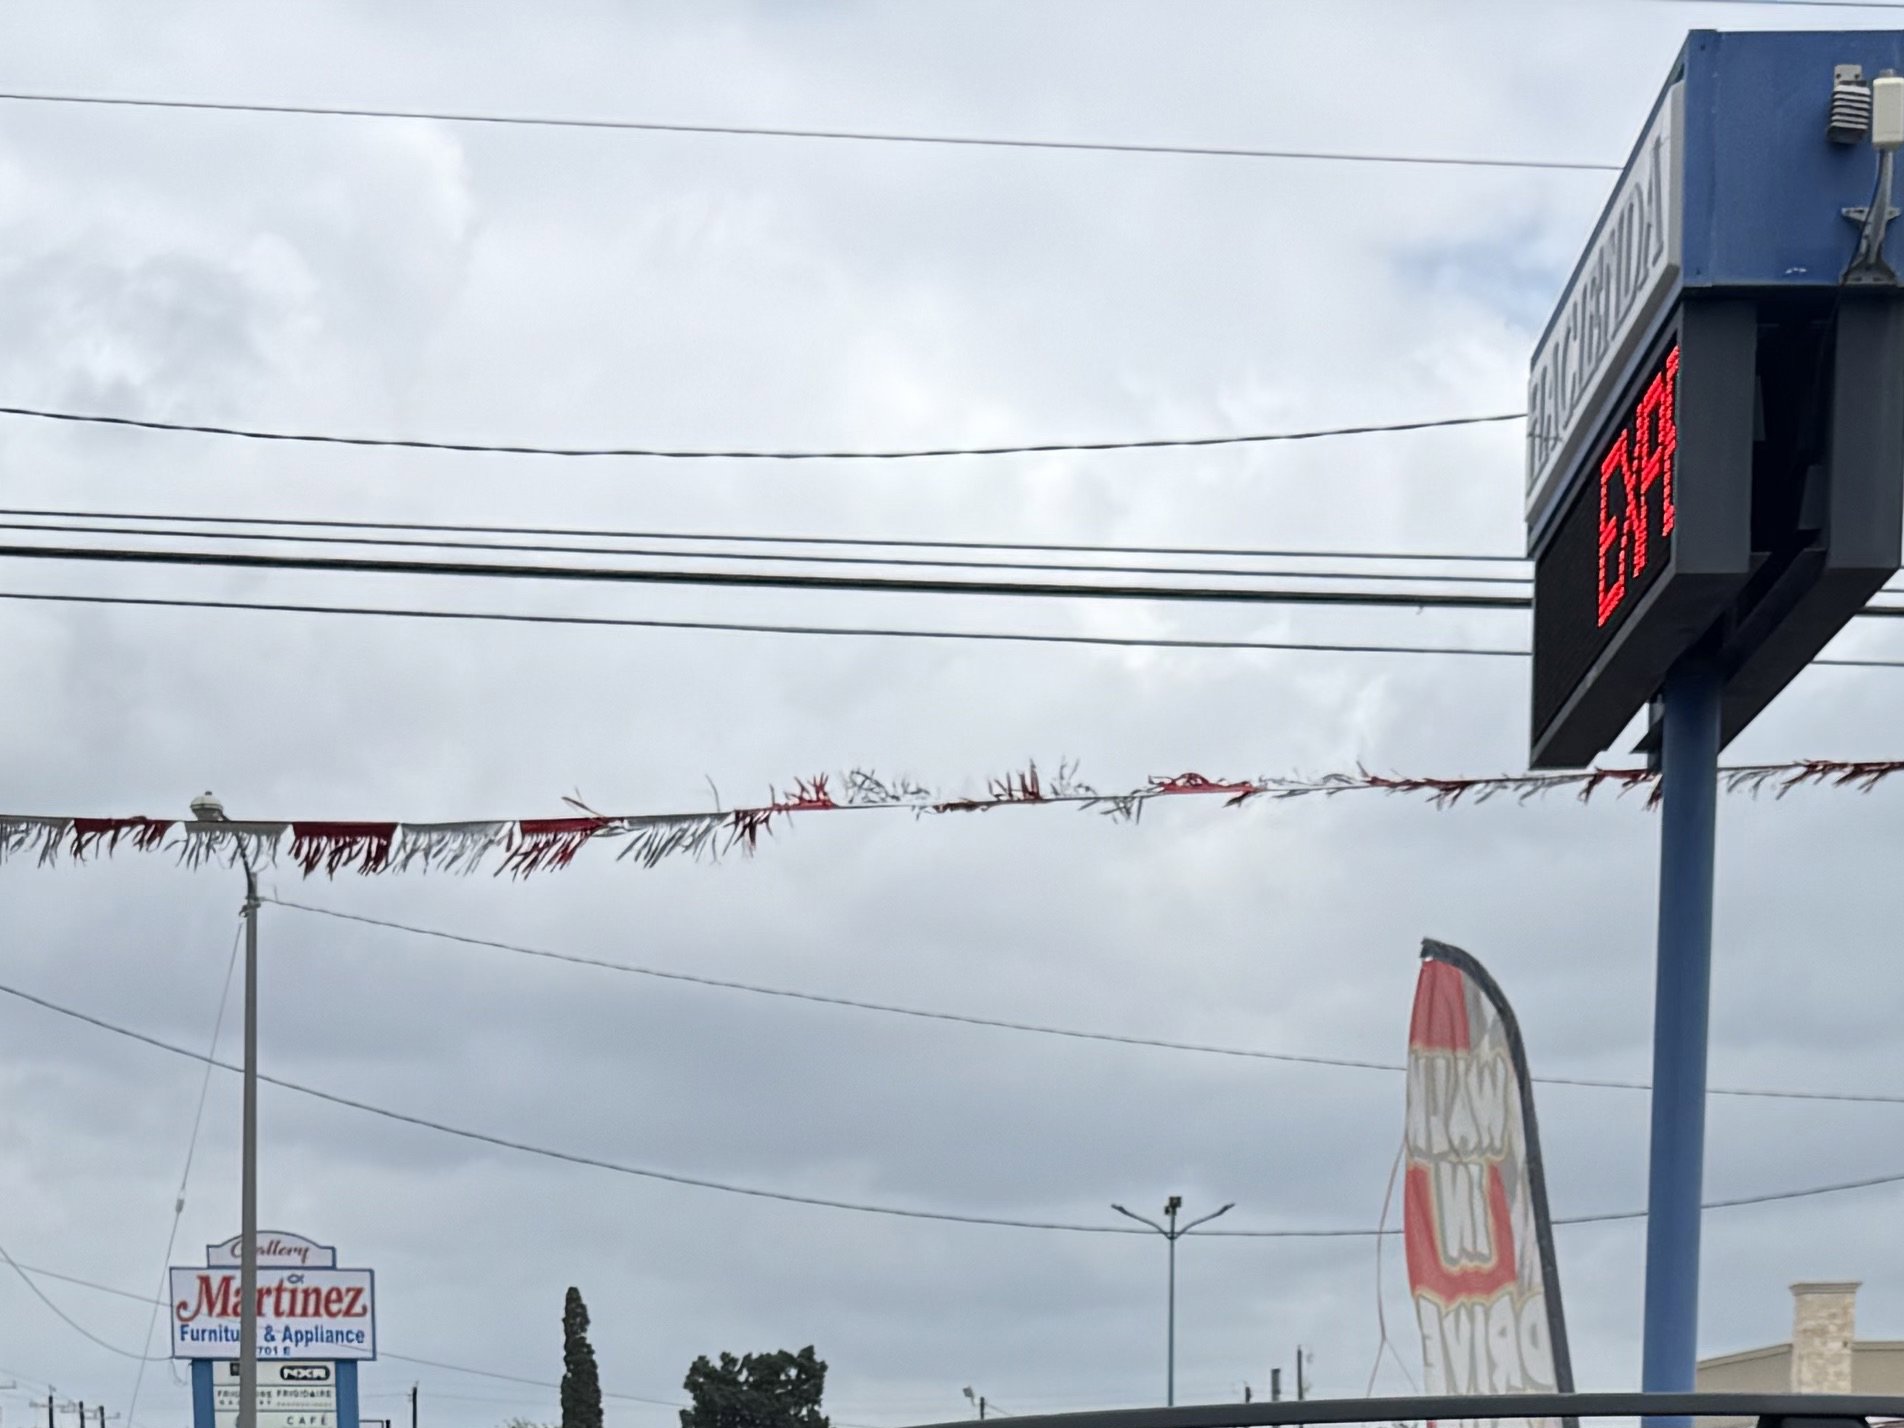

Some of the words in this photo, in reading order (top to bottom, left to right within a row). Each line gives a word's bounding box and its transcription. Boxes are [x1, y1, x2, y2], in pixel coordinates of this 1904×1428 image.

[180, 1324, 242, 1343] Furnitu
[263, 1324, 276, 1342] &
[282, 1324, 365, 1347] Appliance
